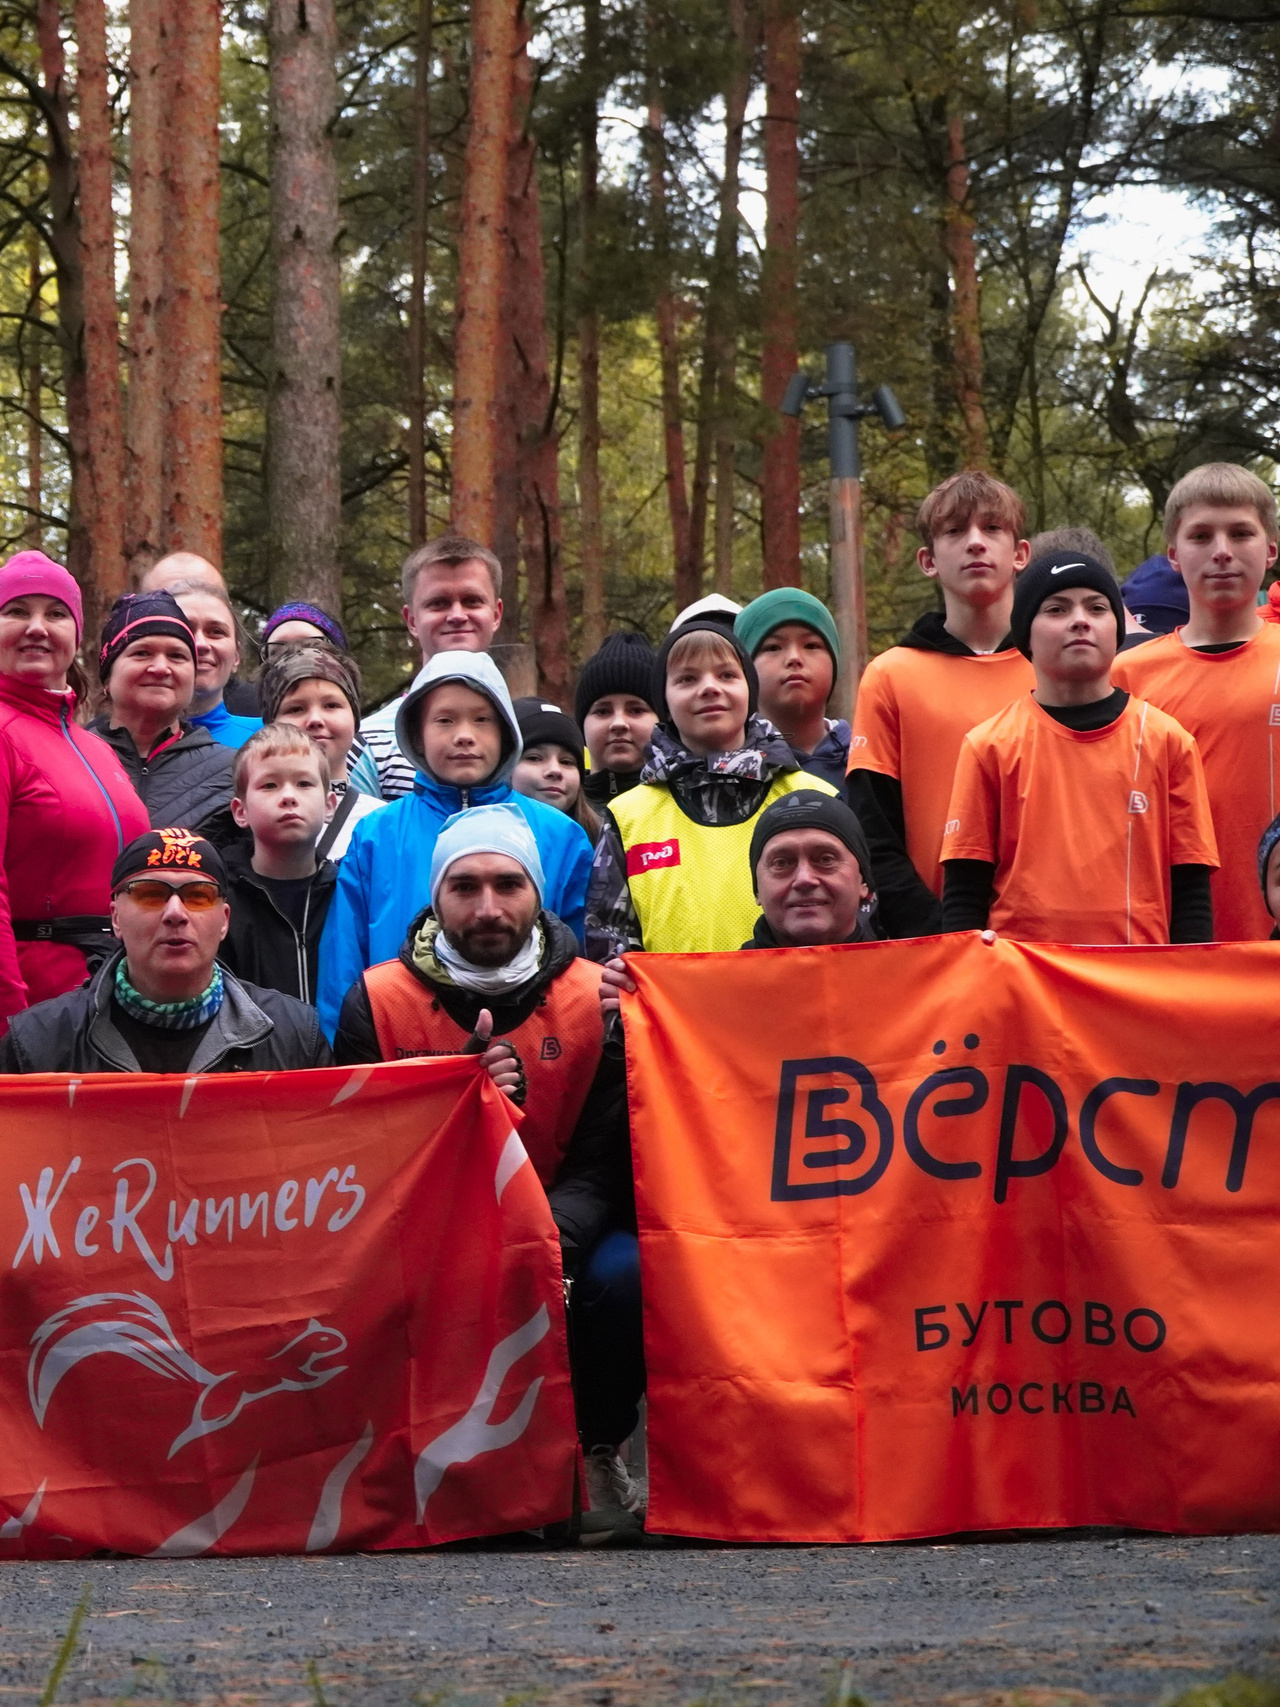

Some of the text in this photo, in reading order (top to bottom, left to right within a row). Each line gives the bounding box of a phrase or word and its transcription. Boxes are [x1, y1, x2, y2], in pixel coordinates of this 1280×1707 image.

[147, 847, 202, 868] ROCK
[914, 1300, 1167, 1353] БУТОВО
[951, 1382, 1137, 1418] МОСКВА
